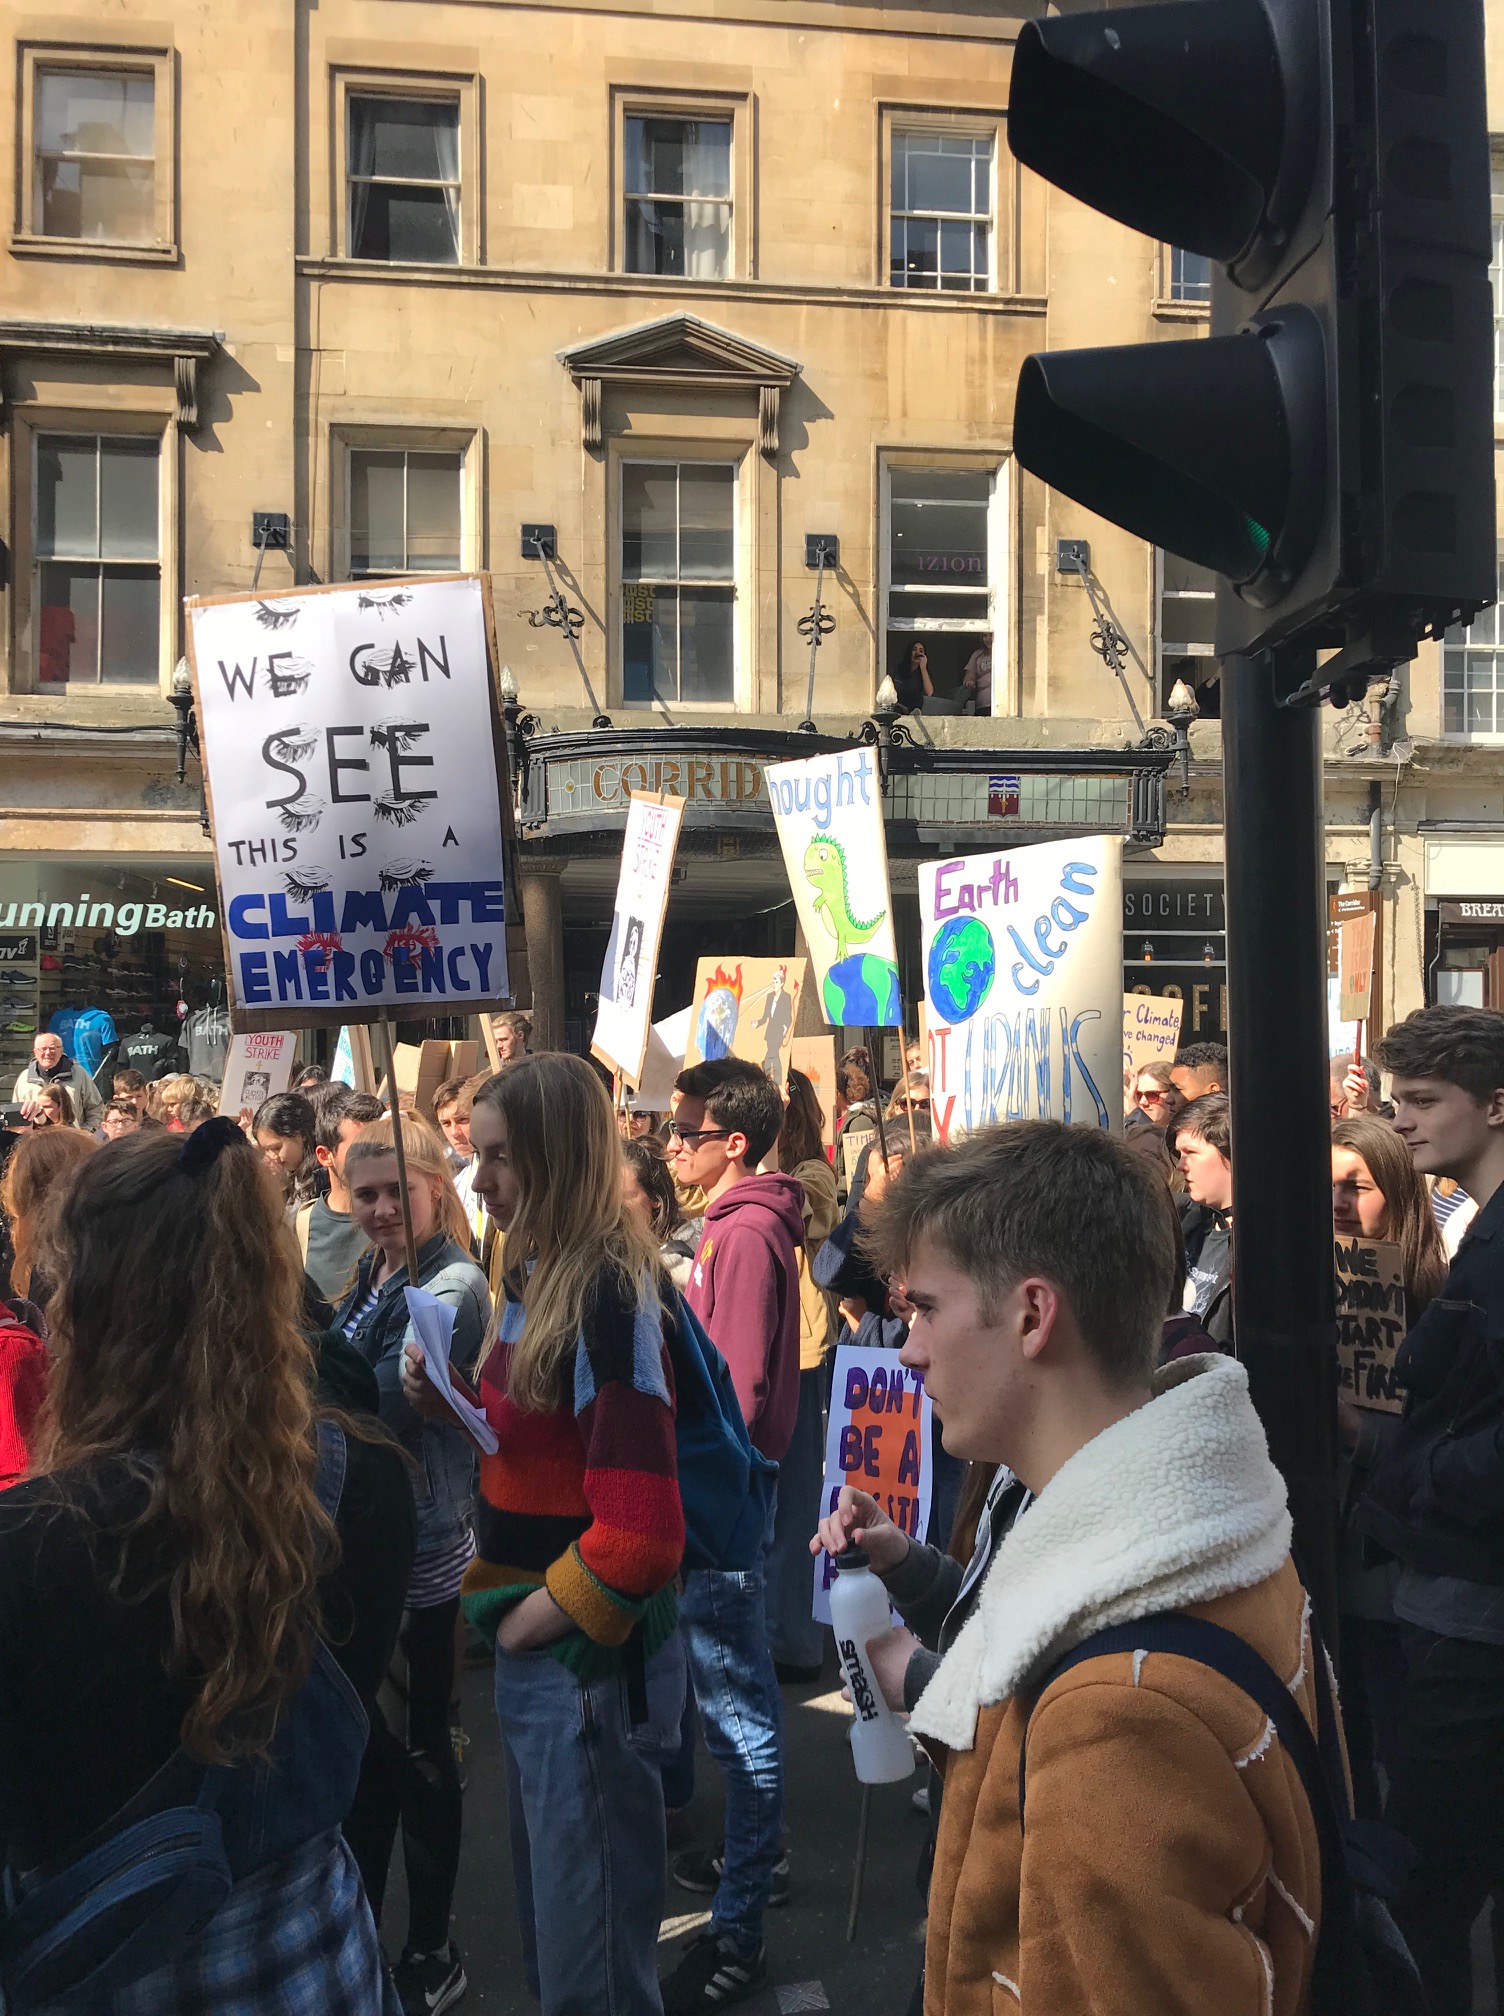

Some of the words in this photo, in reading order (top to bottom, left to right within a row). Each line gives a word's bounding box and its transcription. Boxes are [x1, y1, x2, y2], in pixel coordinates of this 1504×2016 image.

[217, 651, 297, 702] WE
[349, 635, 451, 686] CAN
[262, 723, 439, 809] SEE
[227, 836, 299, 867] THIS
[338, 832, 368, 860] IS
[442, 825, 460, 848] A
[228, 880, 505, 940] CLIMATE
[933, 859, 1019, 921] Earth
[1006, 861, 1098, 996] clean
[239, 943, 494, 1004] EMERGENCY
[127, 1044, 159, 1057] BATH
[244, 1047, 281, 1060] STRIKE
[248, 1034, 284, 1046] YOUTH
[1135, 1030, 1176, 1052] changed
[1335, 1238, 1380, 1278] WE
[843, 1366, 925, 1420] DON'T
[839, 1424, 883, 1478] BE
[897, 1429, 920, 1487] A
